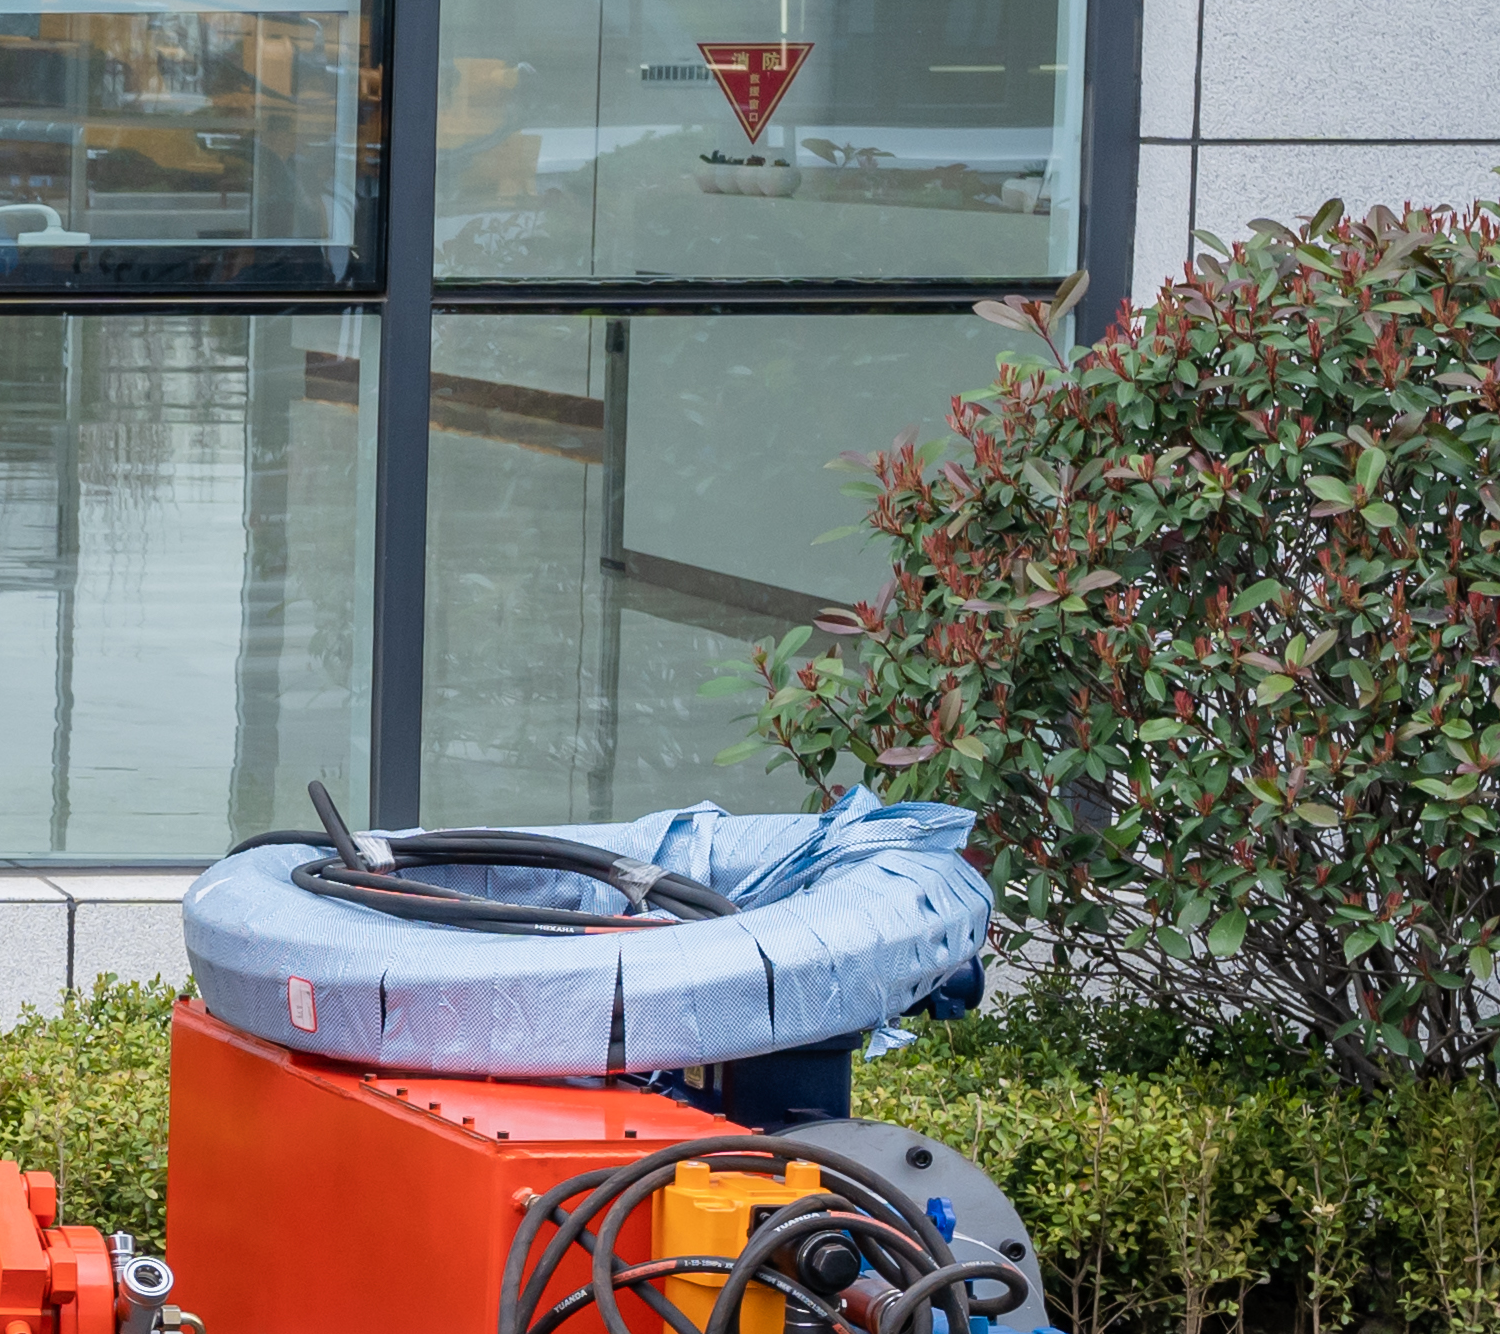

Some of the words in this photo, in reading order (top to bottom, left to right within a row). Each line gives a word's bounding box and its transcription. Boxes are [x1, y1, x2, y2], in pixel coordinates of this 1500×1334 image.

[731, 52, 781, 71] 消防
[773, 1212, 820, 1232] YUANDA
[553, 1289, 588, 1314] YUANDA
